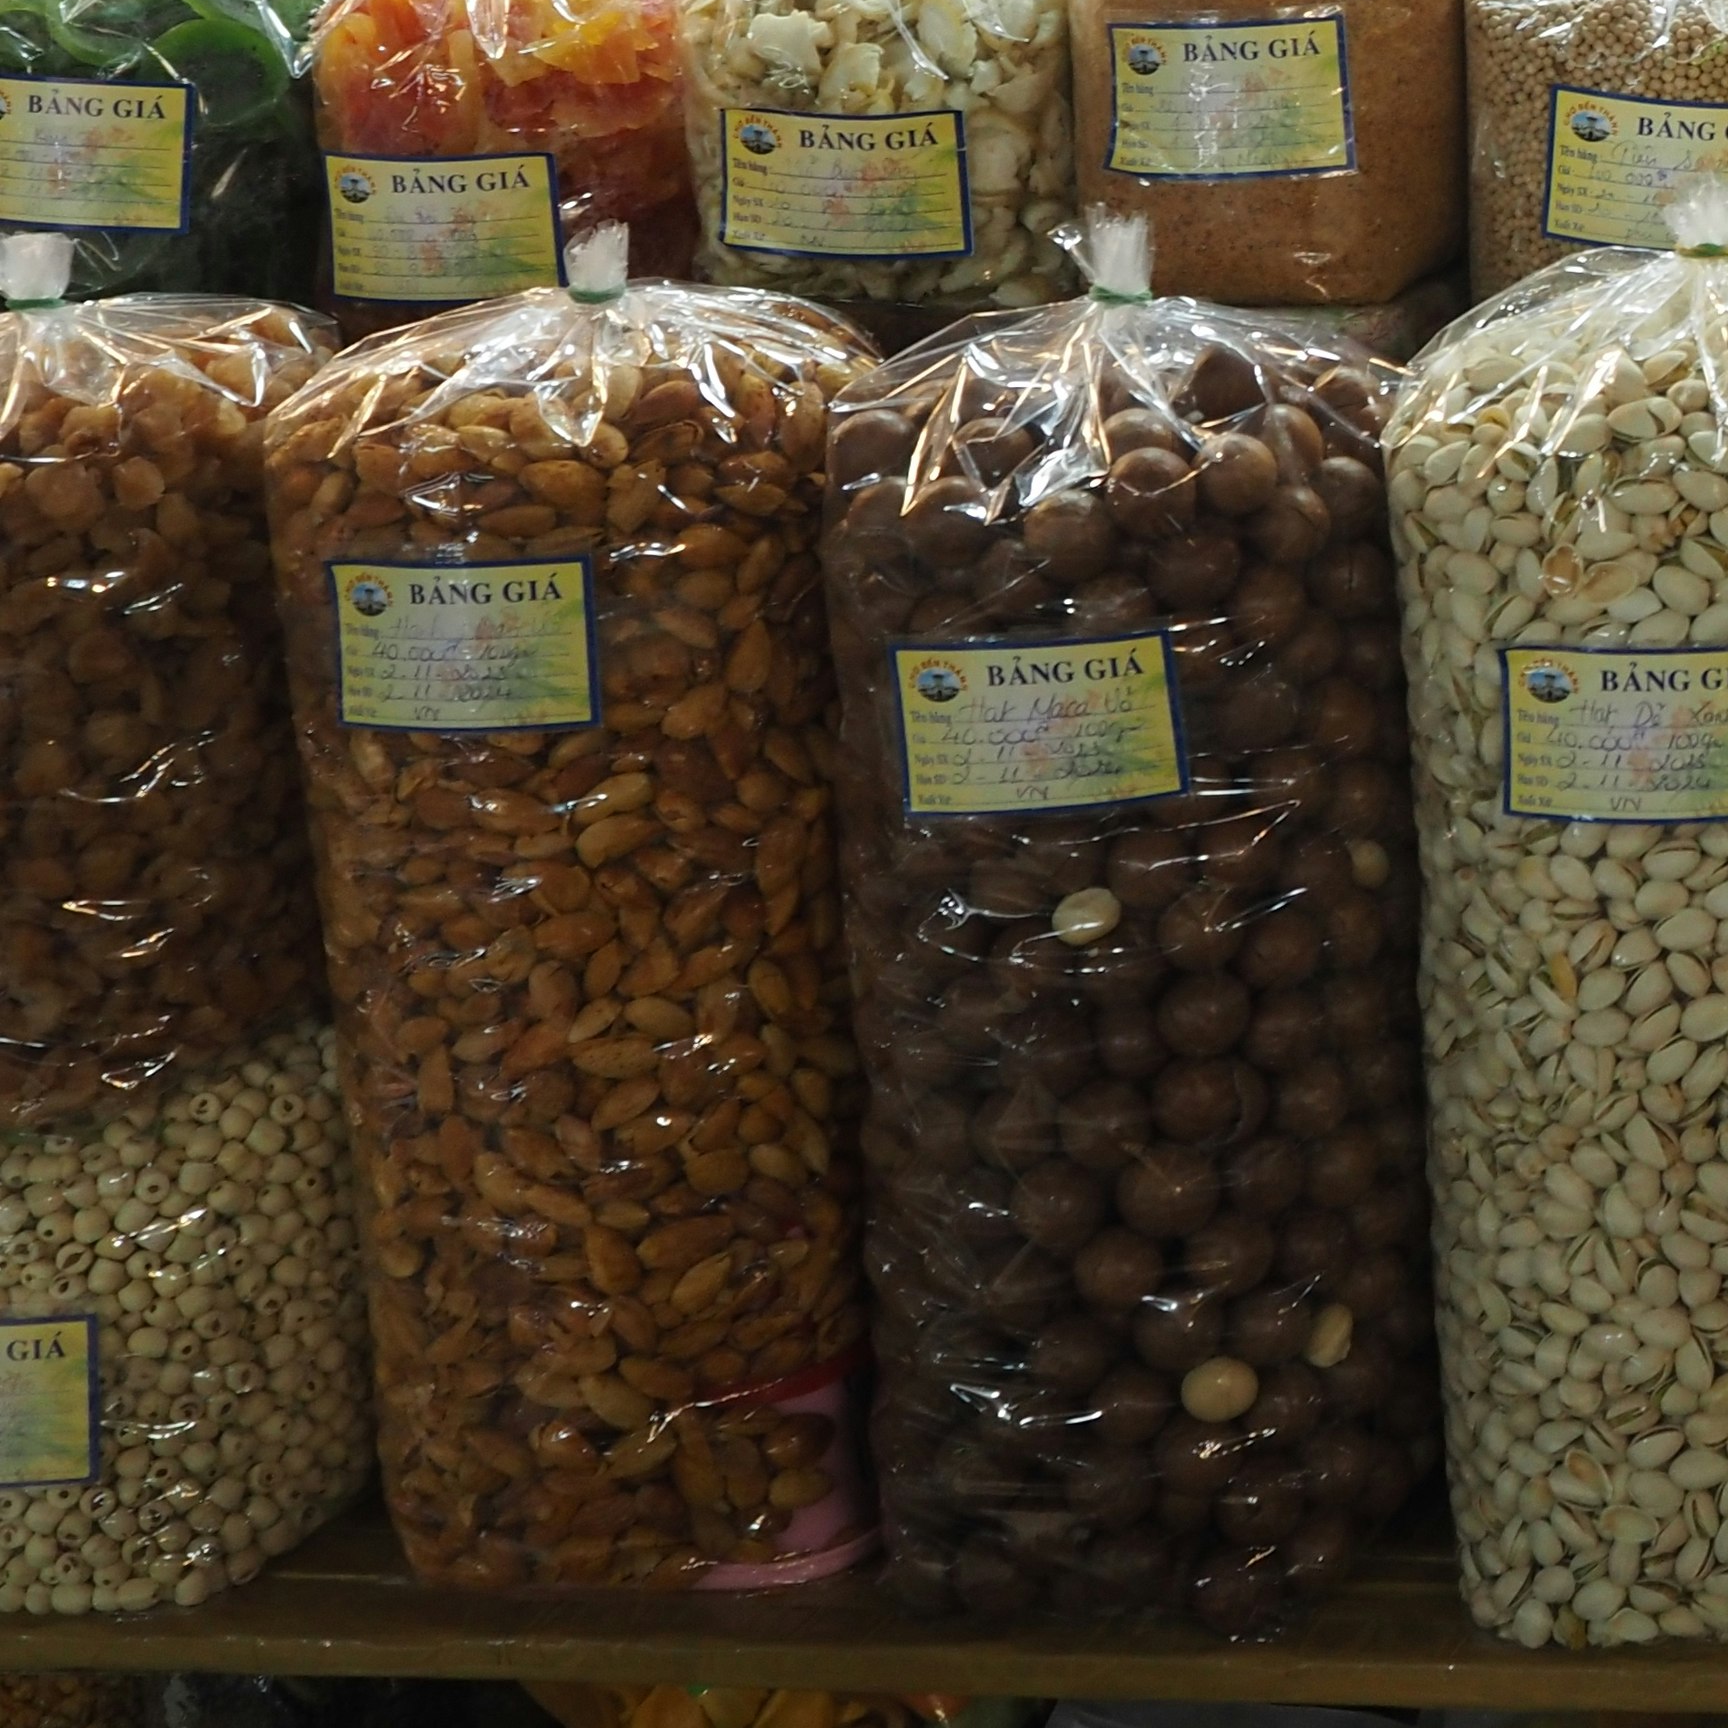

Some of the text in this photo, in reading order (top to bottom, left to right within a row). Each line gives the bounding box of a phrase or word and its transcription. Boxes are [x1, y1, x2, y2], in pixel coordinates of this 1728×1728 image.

[28, 92, 166, 119] BẢNG GIÁ
[800, 126, 938, 151] BẢNG GIÁ
[988, 648, 1142, 687] BẢNG GIÁ
[1601, 660, 1691, 693] BẢNG
[7, 1329, 66, 1362] GIÁ
